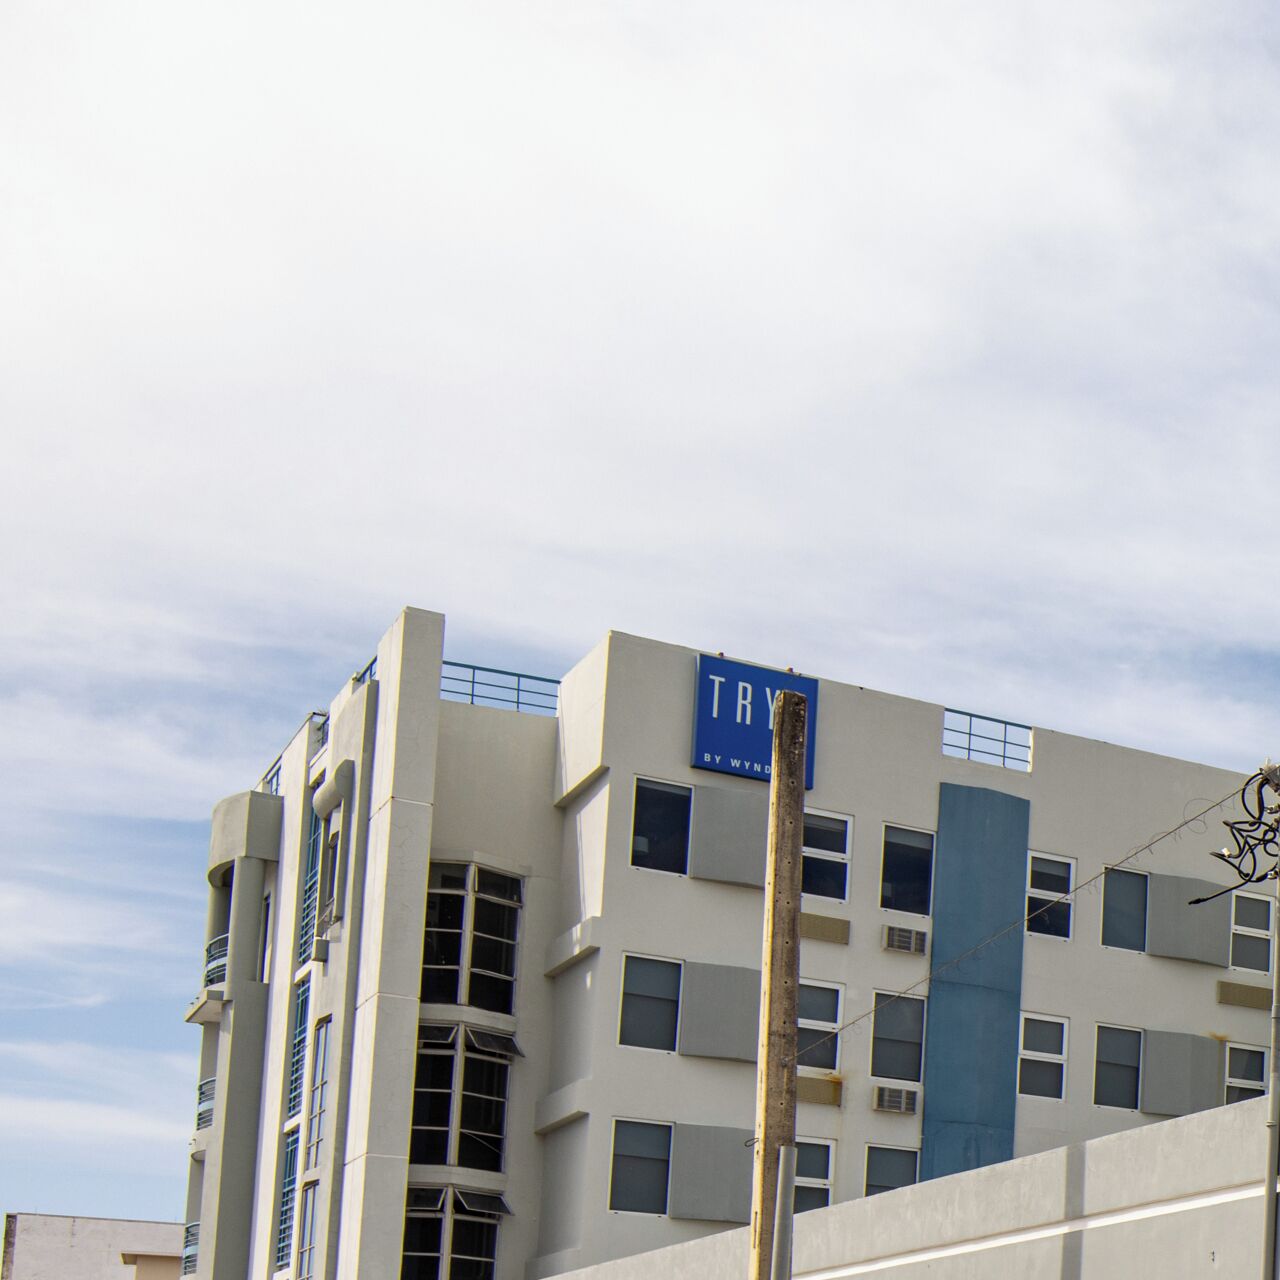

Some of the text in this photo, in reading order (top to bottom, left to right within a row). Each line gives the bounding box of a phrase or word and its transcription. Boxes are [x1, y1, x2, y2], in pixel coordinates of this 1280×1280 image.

[709, 674, 781, 730] TRY
[704, 753, 772, 774] BY WYND
